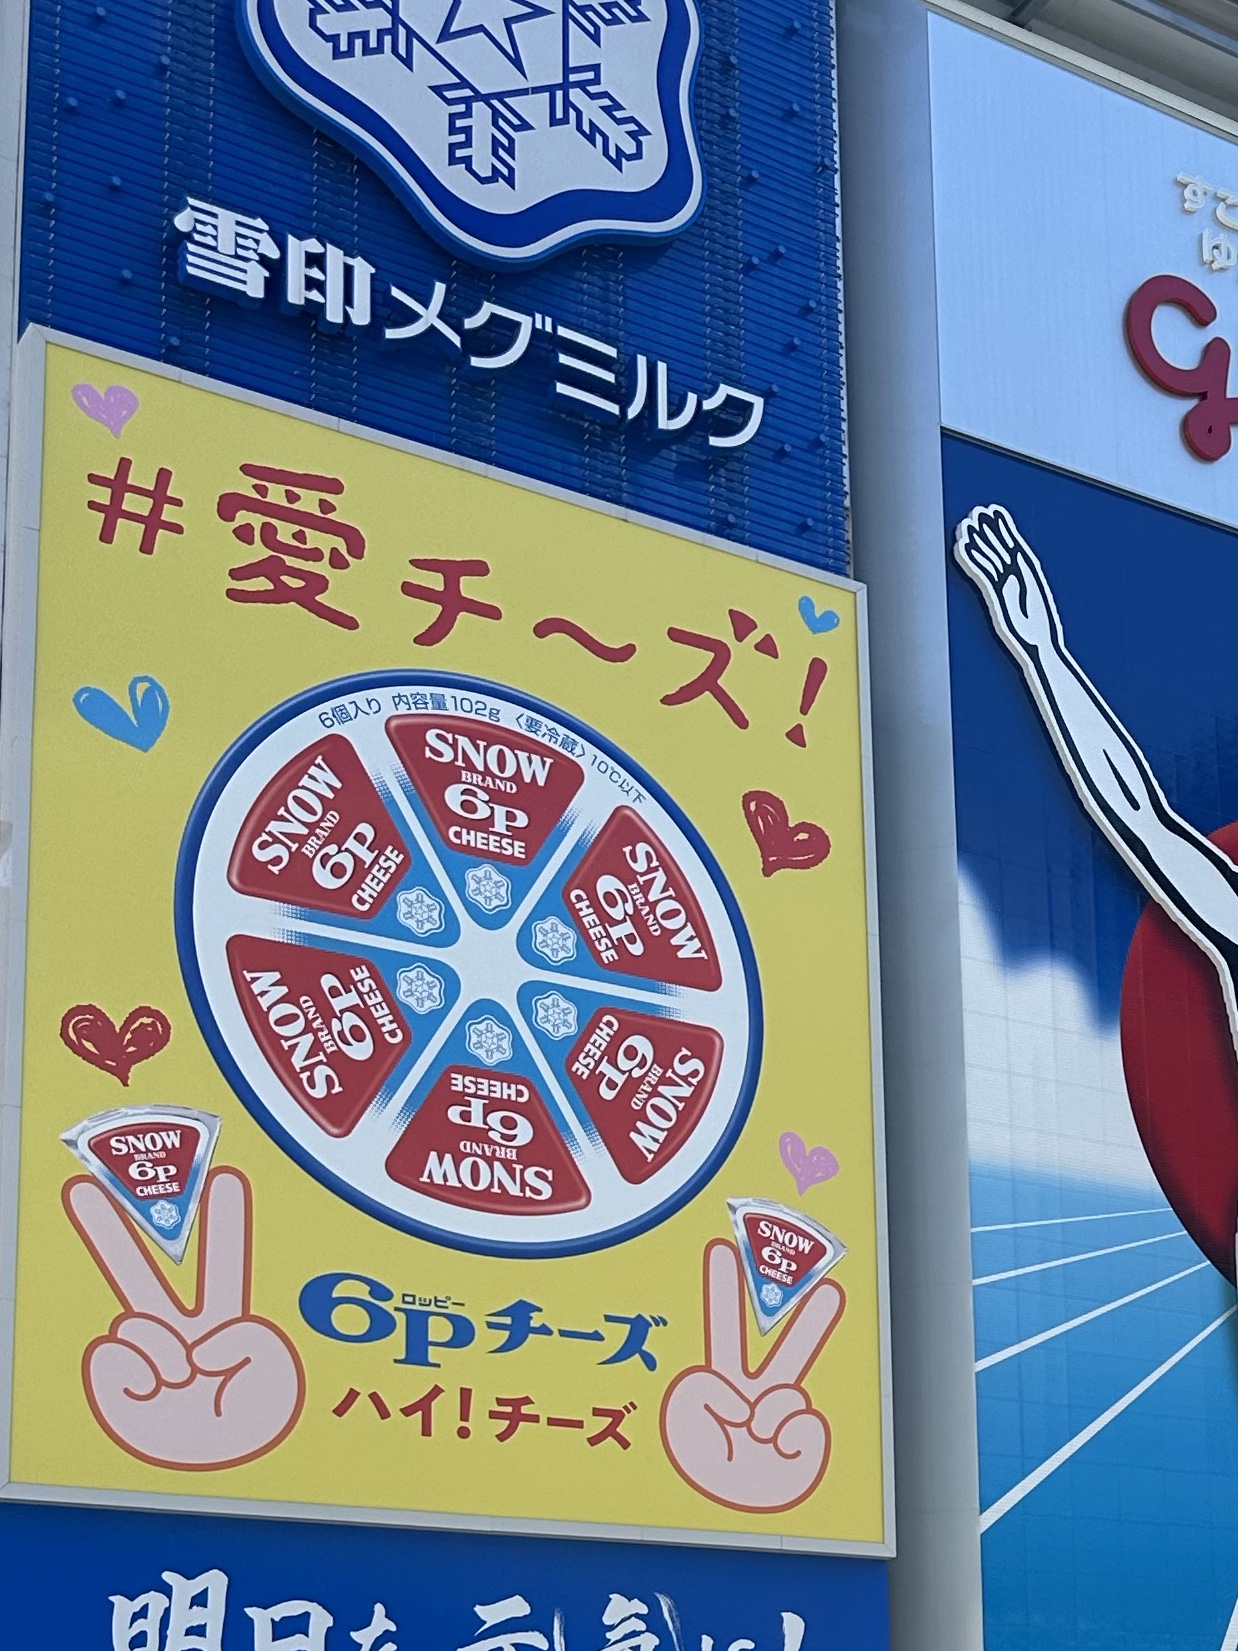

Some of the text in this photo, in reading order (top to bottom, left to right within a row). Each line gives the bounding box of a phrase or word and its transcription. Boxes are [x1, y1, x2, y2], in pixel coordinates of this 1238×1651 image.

[174, 197, 764, 449] 雪印メグミルク
[318, 696, 382, 728] 6個入り
[392, 692, 501, 722] 内容量102g
[589, 753, 647, 805] 10℃以下
[424, 728, 553, 787] SNOW
[444, 782, 529, 837] 6P
[461, 770, 518, 794] BRAND
[252, 755, 343, 875] SNOW
[301, 810, 340, 858] BRAND
[448, 825, 526, 859] CHEESE
[312, 822, 378, 890] 6P
[351, 845, 405, 911] CHEESE
[569, 888, 619, 964] CHEESE
[596, 874, 644, 956] 6P
[622, 842, 708, 960] SNOW
[628, 882, 662, 936] BRAND
[299, 995, 338, 1054] BRAND
[320, 972, 374, 1060] 6P
[349, 965, 404, 1044] CHEESE
[243, 970, 343, 1099] SNOW
[571, 1015, 619, 1080] CHEESE
[450, 1073, 529, 1102] CHEESE
[595, 1035, 654, 1100] 6P
[630, 1064, 664, 1110] BRAND
[447, 1096, 533, 1147] 6P
[629, 1047, 705, 1163] SNOW
[109, 1130, 182, 1155] SNOW
[460, 1140, 518, 1160] BRAND
[128, 1160, 177, 1182] 6P
[136, 1182, 181, 1196] CHEESE
[419, 1151, 553, 1200] SNOW
[757, 1221, 814, 1254] SNOW
[761, 1246, 798, 1274] 6P
[401, 1293, 465, 1309] ロッピー
[759, 1265, 793, 1285] CHEESE
